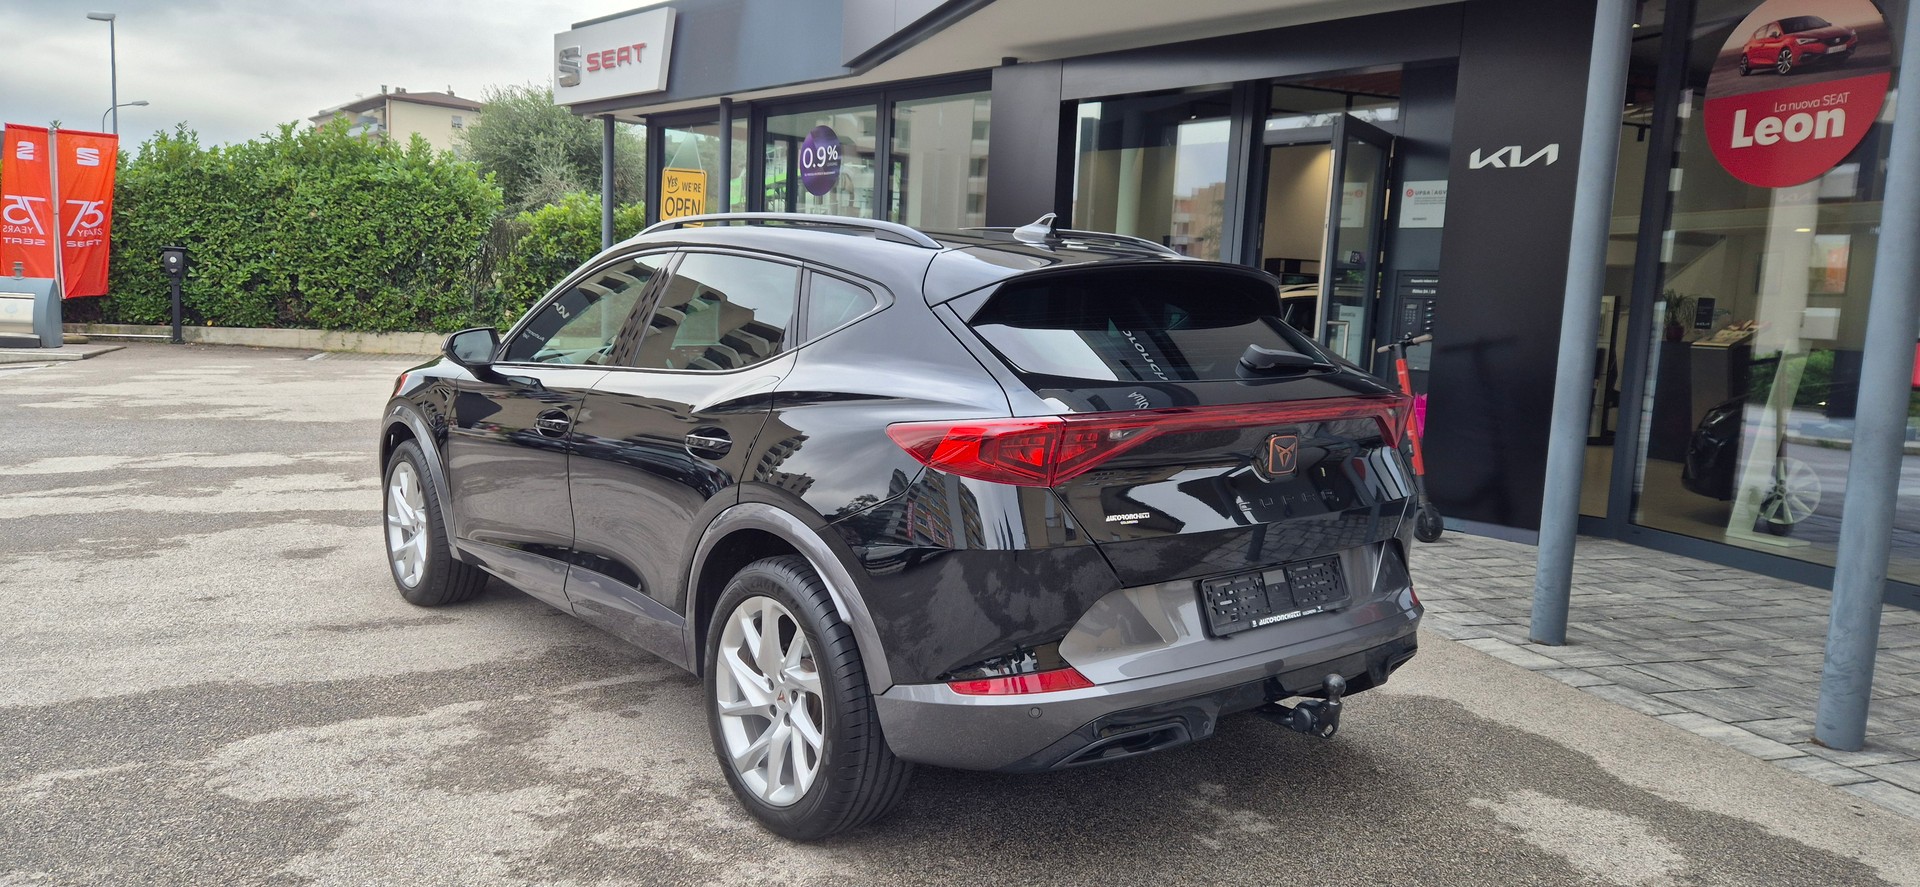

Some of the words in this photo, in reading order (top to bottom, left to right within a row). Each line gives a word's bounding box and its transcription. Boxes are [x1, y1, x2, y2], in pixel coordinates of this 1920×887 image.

[586, 42, 648, 73] SEAT
[1774, 102, 1787, 113] La
[1788, 98, 1821, 111] nuova
[1822, 91, 1850, 107] SEAT
[1731, 107, 1847, 149] Leon
[802, 144, 839, 169] 0.9%
[1469, 143, 1559, 169] KIA
[681, 181, 702, 193] WE'RE
[66, 200, 104, 237] 75
[665, 196, 701, 217] OPEN
